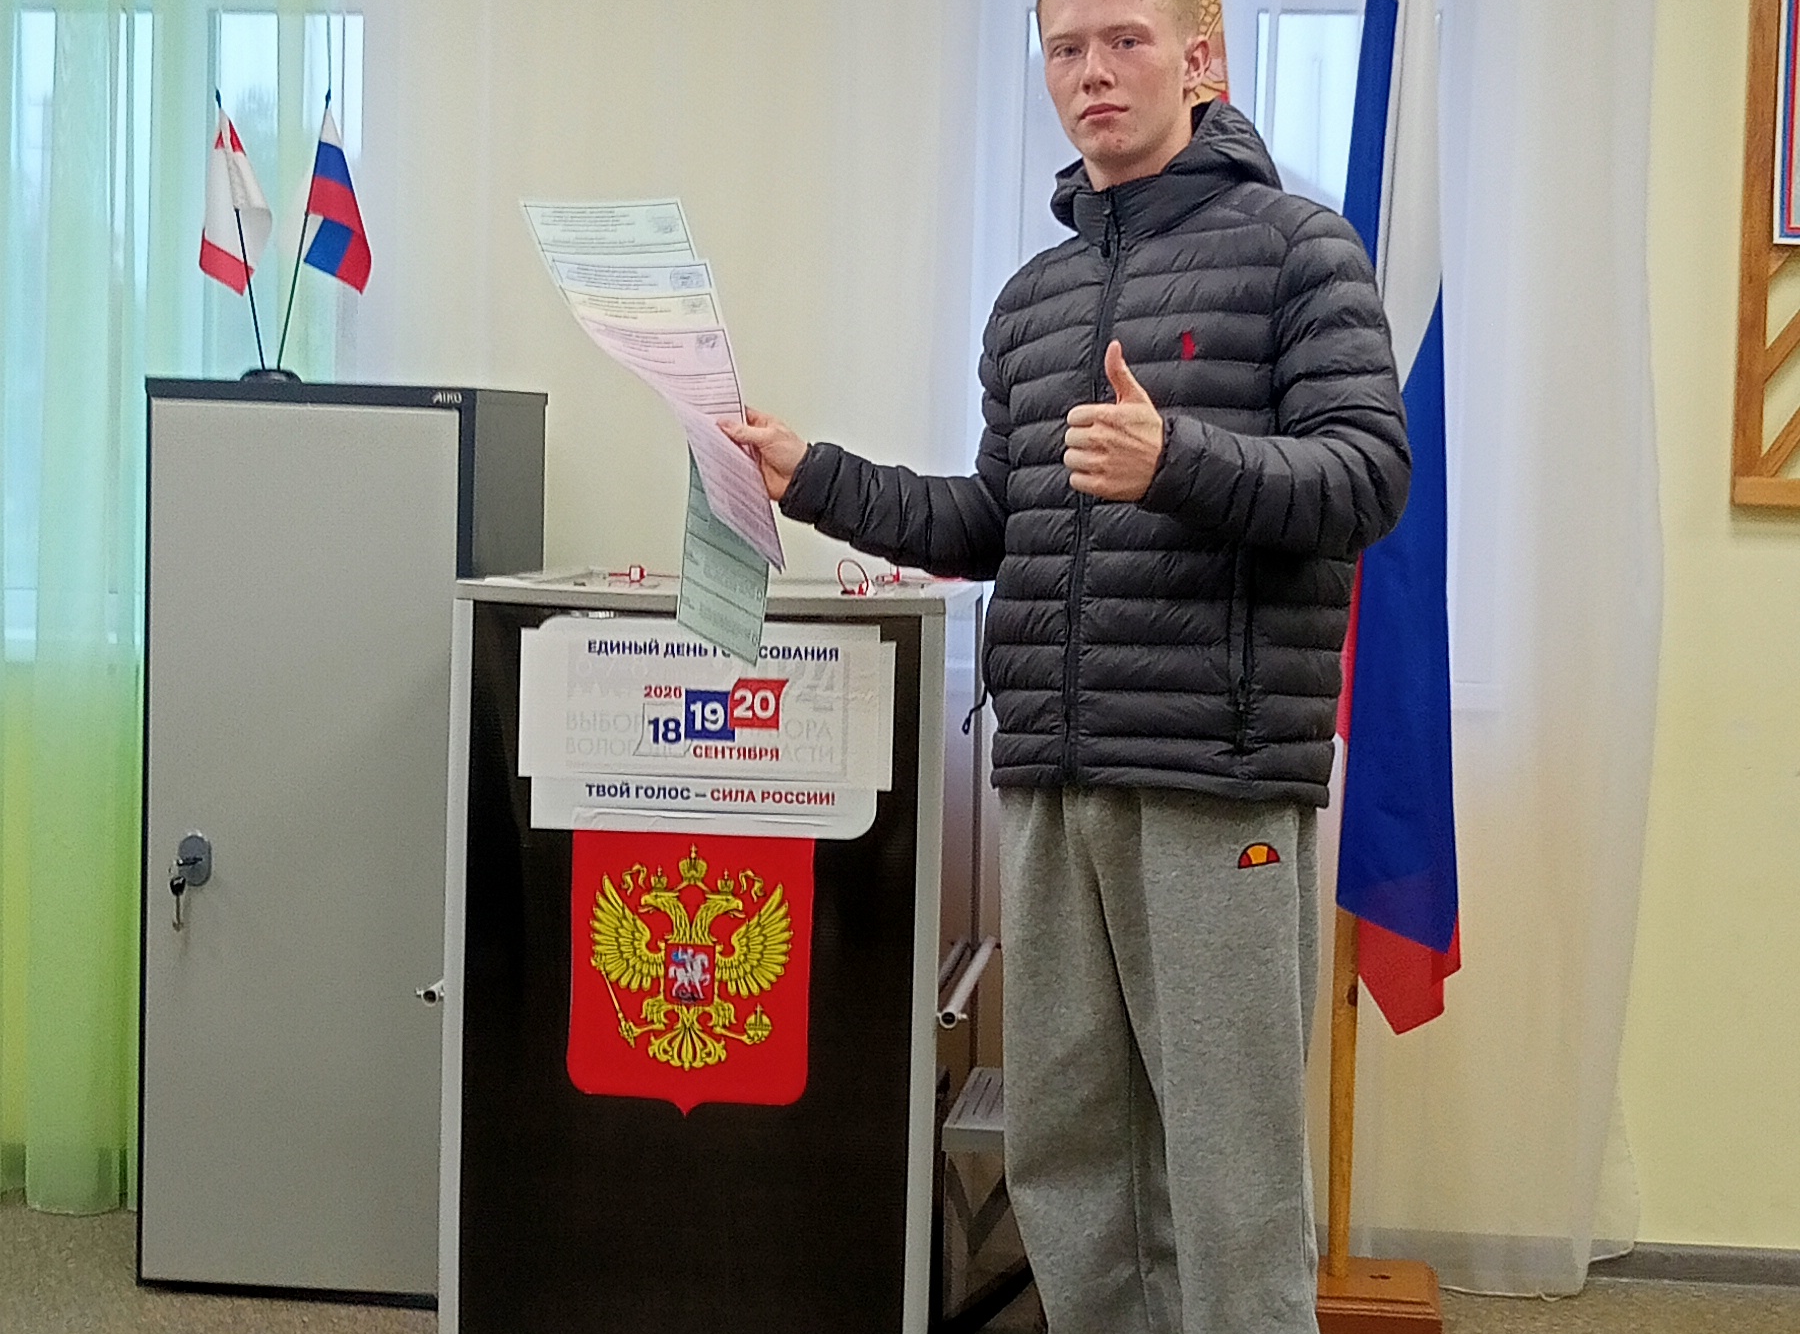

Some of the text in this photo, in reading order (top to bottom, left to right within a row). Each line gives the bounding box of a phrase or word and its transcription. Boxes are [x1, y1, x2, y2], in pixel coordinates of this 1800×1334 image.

[588, 638, 839, 662] ЕДИНЫЙ ДЕНЬ ГСОВАНИЯ
[648, 688, 776, 744] 18 19 20
[693, 745, 779, 761] СЕНТЯБРЯ
[585, 780, 630, 798] ТВОЙ
[635, 784, 691, 800] ГОЛОС
[710, 788, 757, 803] СИЛА
[761, 789, 836, 806] РОССИИ!
